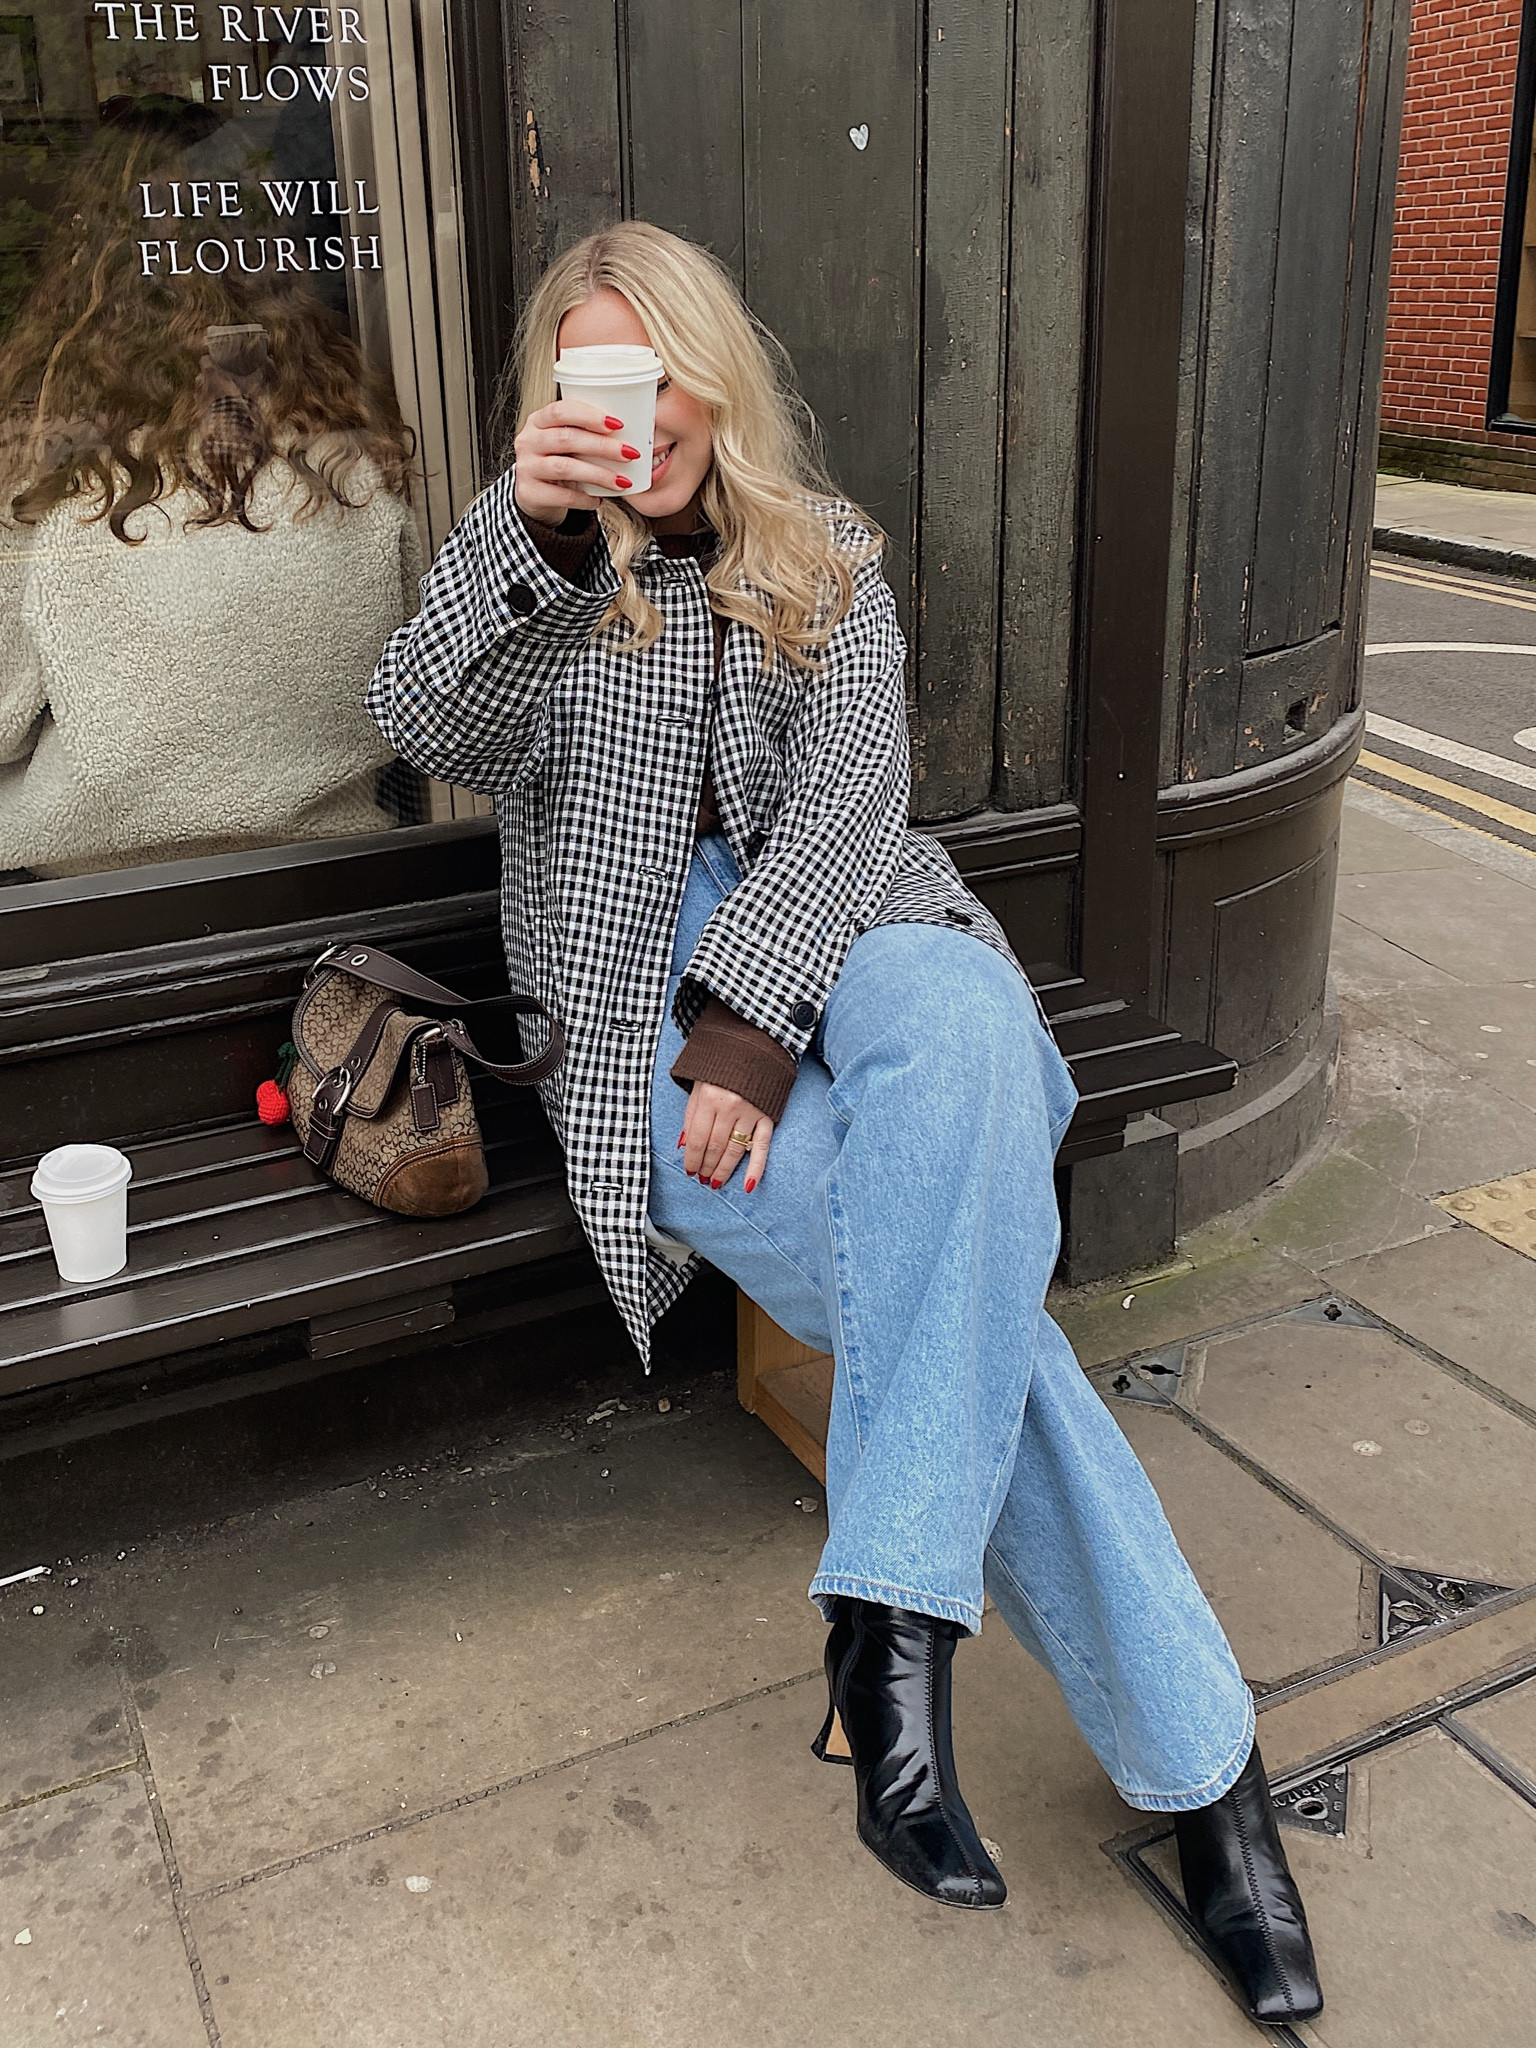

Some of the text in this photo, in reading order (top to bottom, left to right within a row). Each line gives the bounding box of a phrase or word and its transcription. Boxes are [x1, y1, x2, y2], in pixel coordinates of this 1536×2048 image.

[94, 2, 368, 44] THE RIVER
[208, 65, 369, 102] FLOWS
[139, 180, 380, 218] LIFE WILL
[137, 236, 382, 275] FLOURISH
